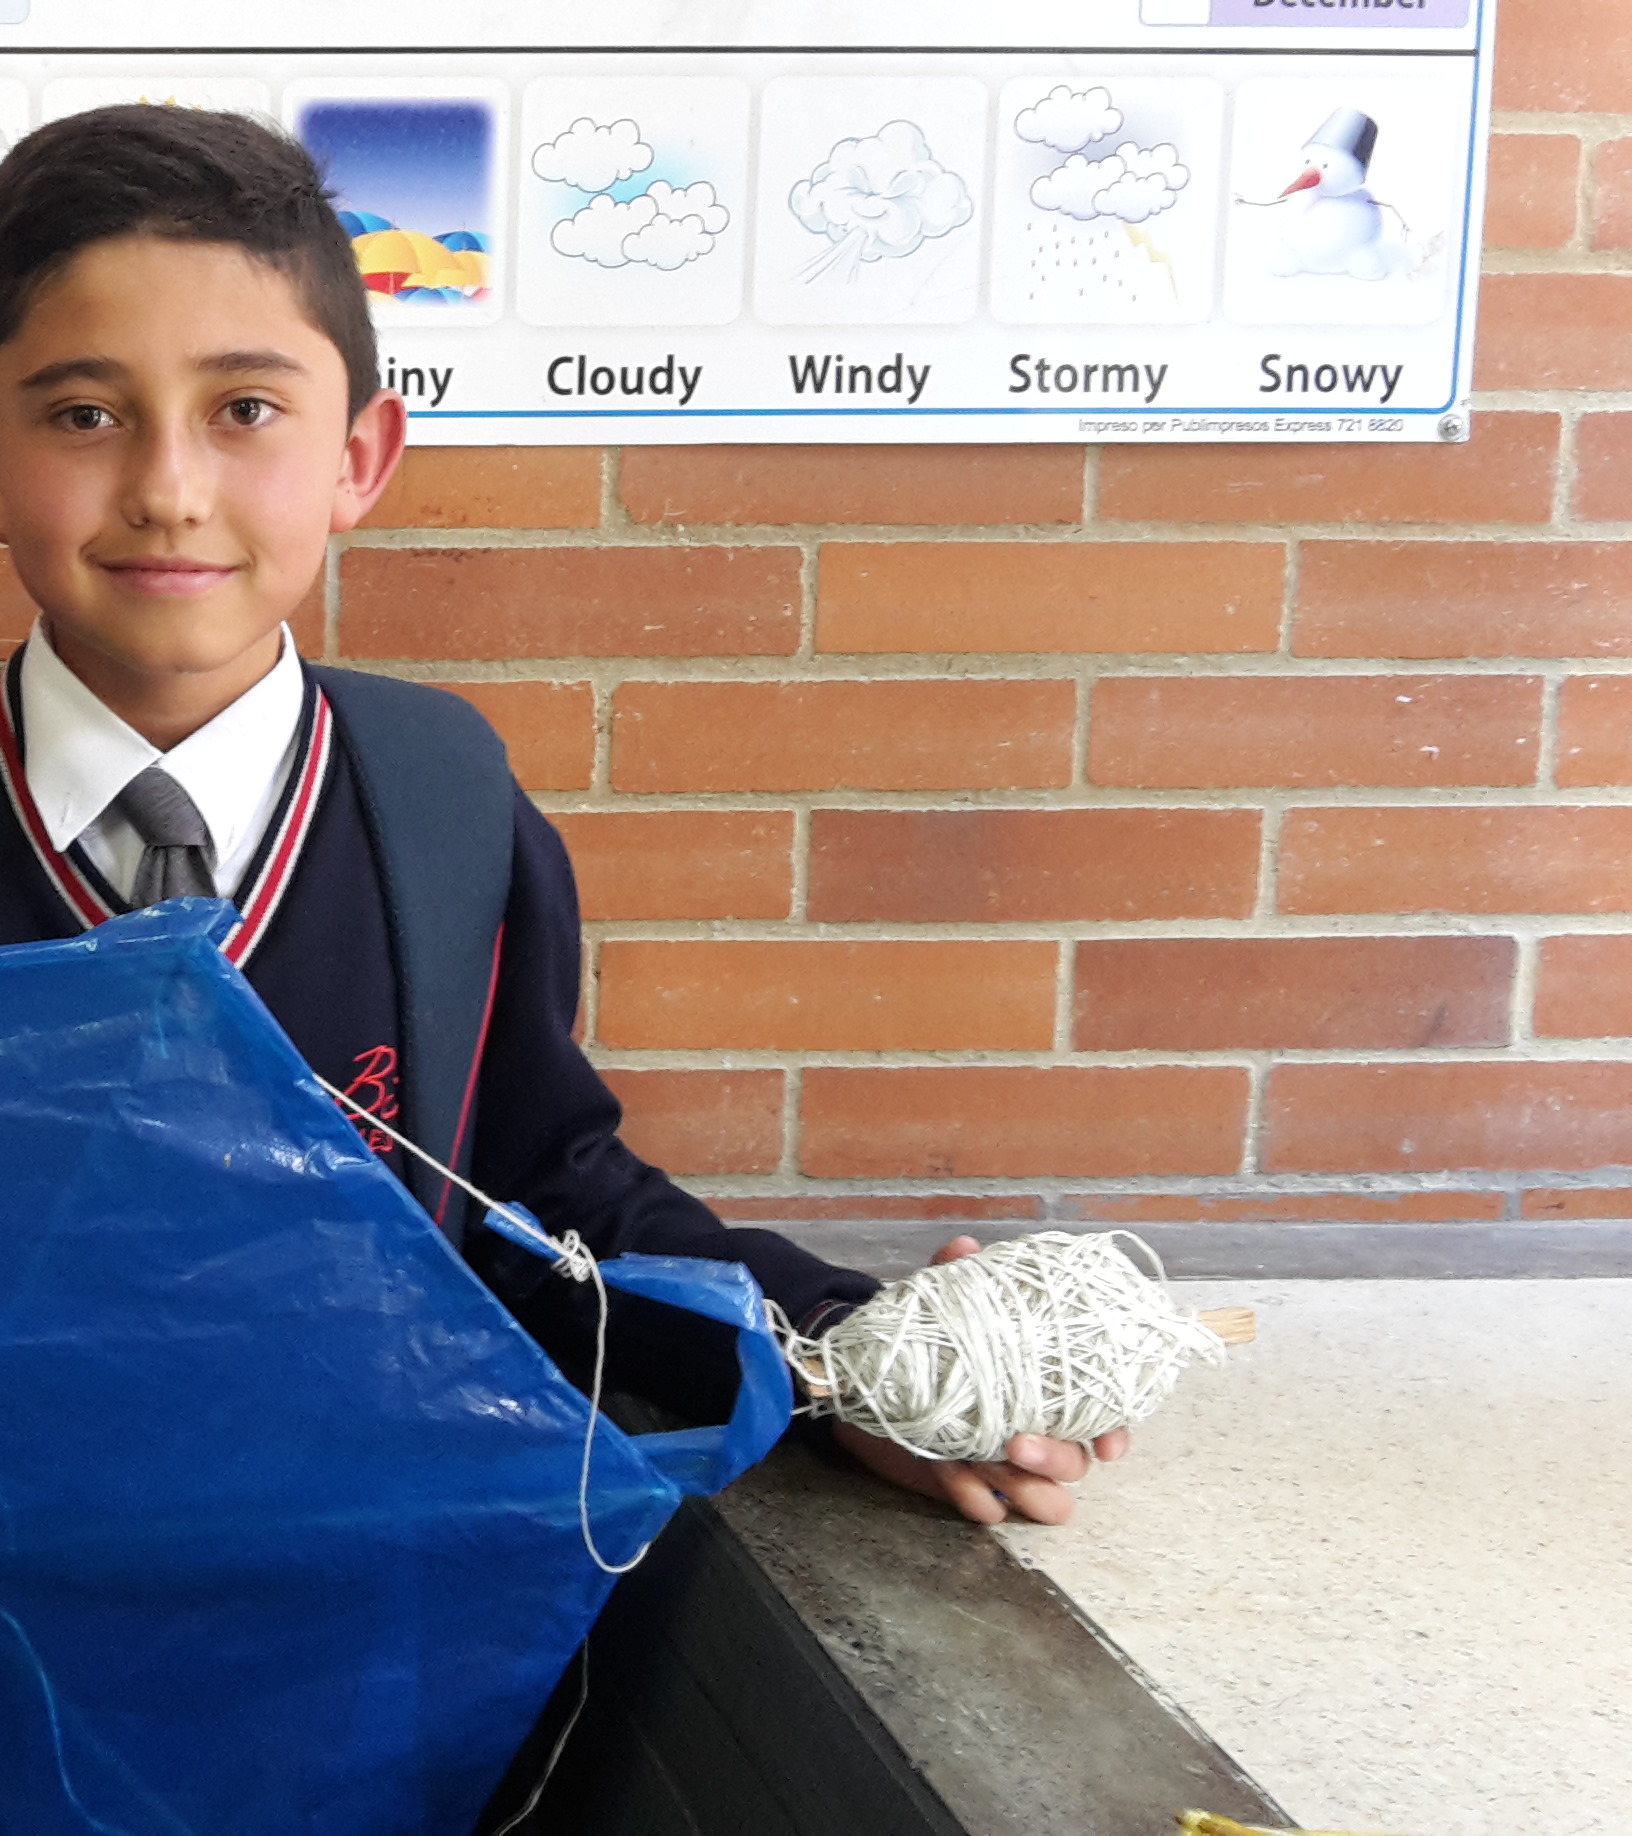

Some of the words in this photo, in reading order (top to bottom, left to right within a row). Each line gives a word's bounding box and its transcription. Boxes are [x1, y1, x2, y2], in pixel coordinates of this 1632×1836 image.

[387, 356, 454, 408] iny
[546, 353, 703, 406] Cloudy
[788, 353, 931, 405] Windy
[1009, 353, 1167, 404] Stormy
[1259, 353, 1404, 404] Snowy
[1078, 418, 1138, 433] Impreso
[1274, 418, 1332, 433] Express
